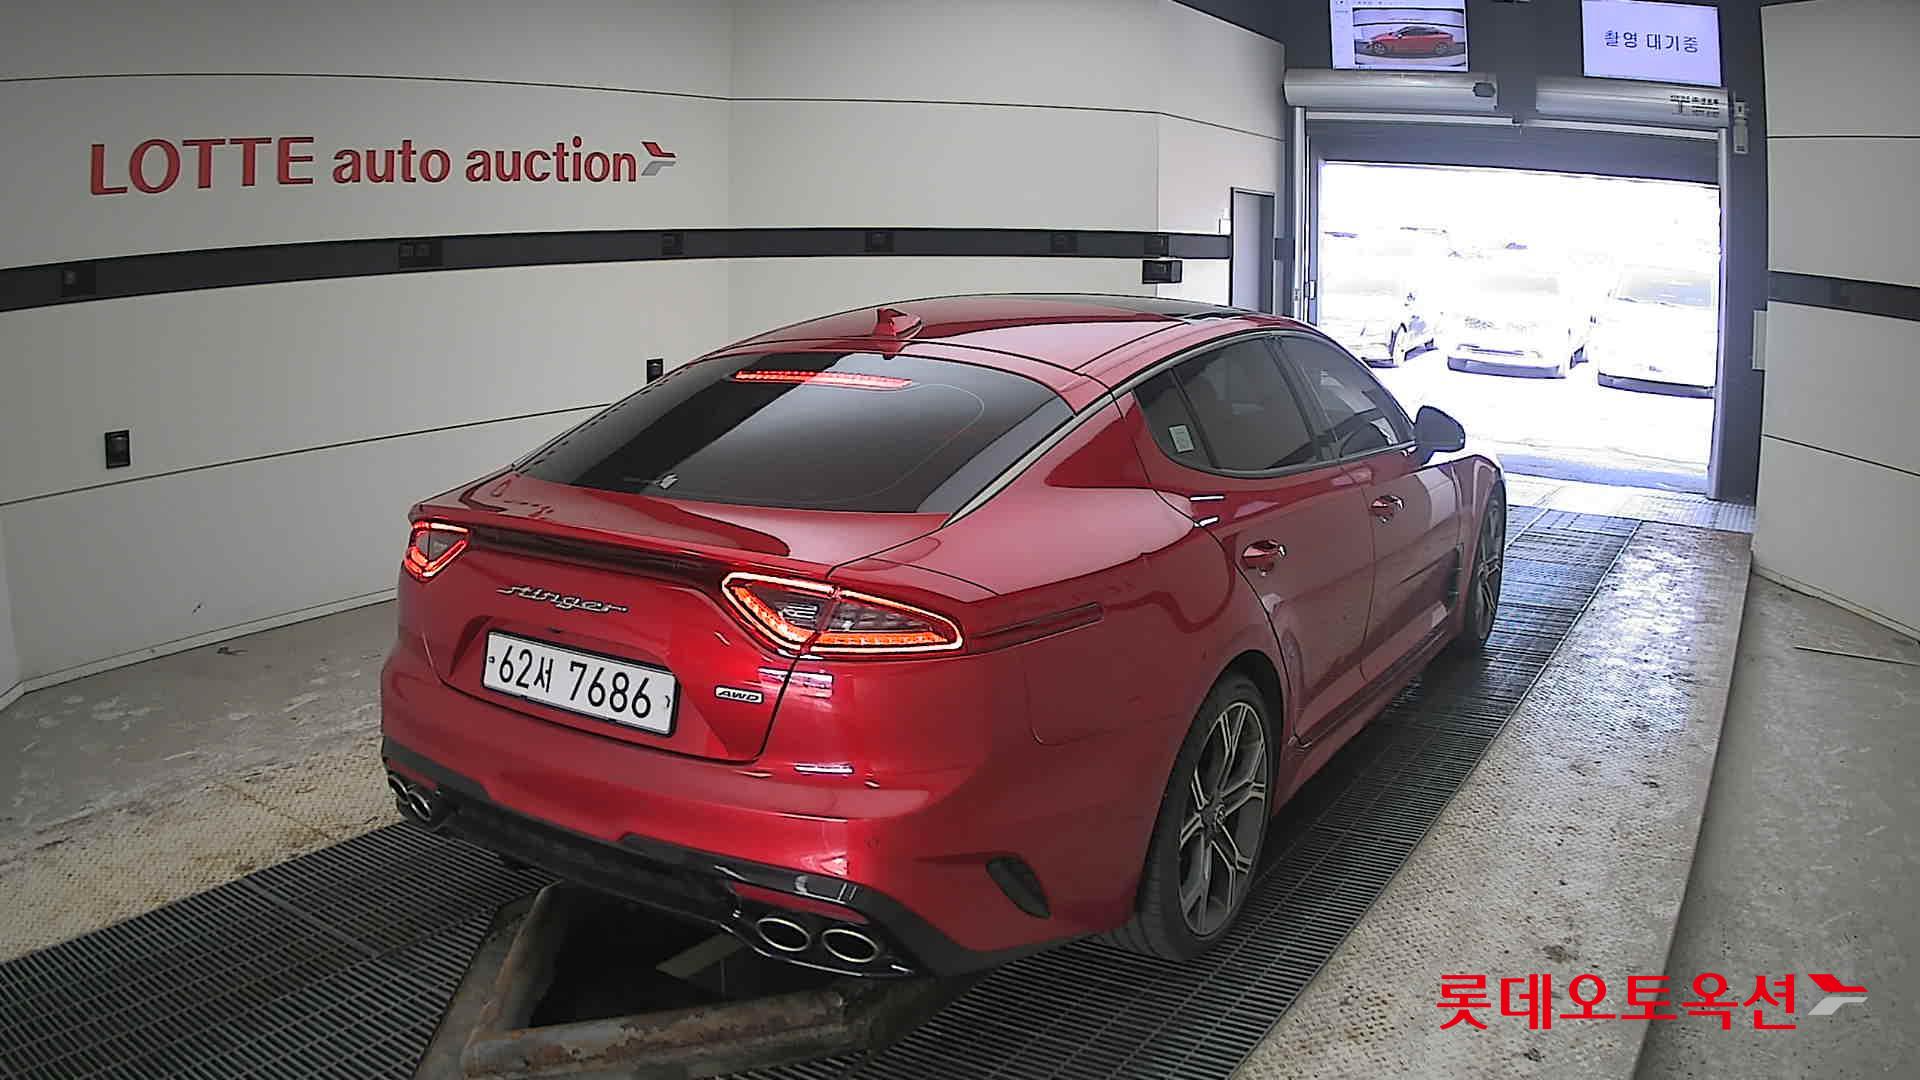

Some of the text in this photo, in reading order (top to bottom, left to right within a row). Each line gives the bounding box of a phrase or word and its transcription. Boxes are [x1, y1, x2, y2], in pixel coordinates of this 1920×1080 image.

[1646, 33, 1699, 53] 대기중
[90, 135, 638, 195] LOTTE auto auction
[498, 644, 652, 719] 62서 7686
[716, 689, 761, 702] AWD
